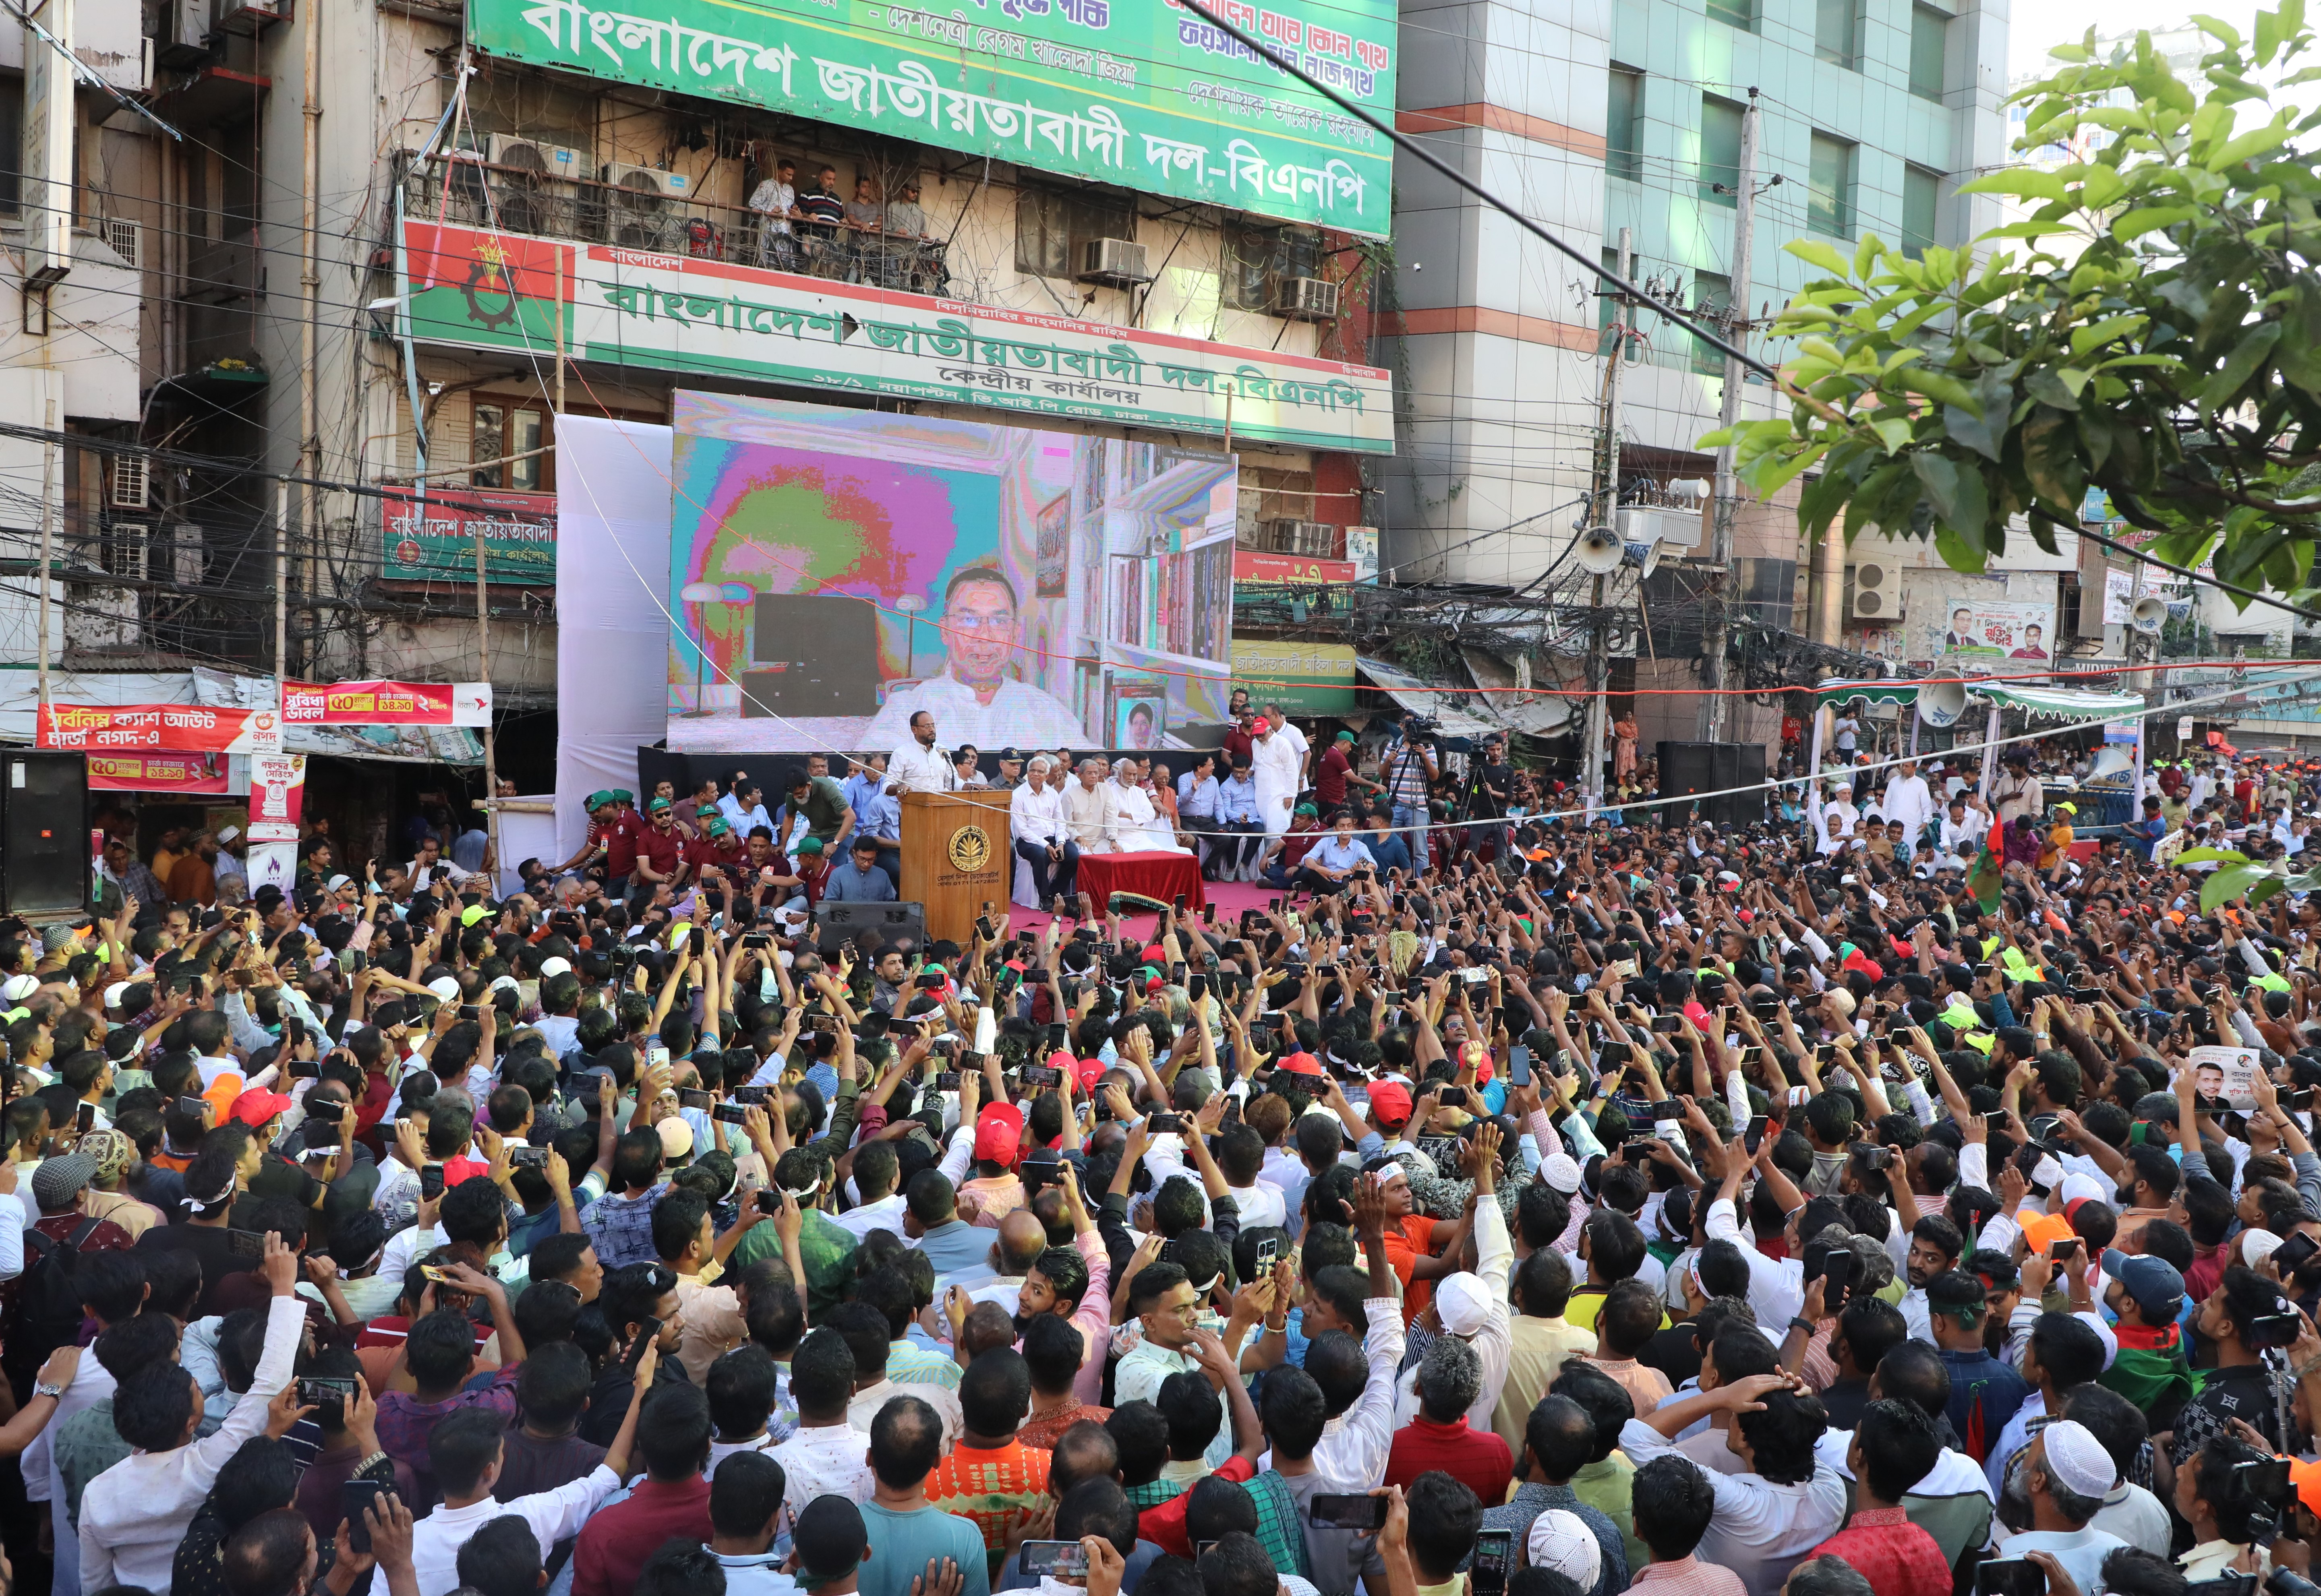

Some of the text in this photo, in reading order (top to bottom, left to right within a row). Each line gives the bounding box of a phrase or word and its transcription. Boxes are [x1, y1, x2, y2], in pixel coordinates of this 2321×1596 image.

[888, 6, 969, 46] দেশনেত্রী
[977, 27, 1025, 60] বেগম
[1032, 40, 1092, 78] খালেদা
[1096, 50, 1137, 89] জিয়া
[1261, 10, 1301, 45] যাবে
[1307, 23, 1351, 60] কোন
[1356, 39, 1388, 70] পথে
[1304, 54, 1374, 96] রাজপথে
[521, 0, 1368, 215] বাংলাদেশ জাতীয়তাবাদী দল-বিএনপি
[1189, 81, 1265, 118] দেশনায়ক
[1269, 99, 1322, 132] তারেক
[608, 249, 684, 271] বাংলাদেশ
[597, 282, 1367, 416] বাংলাদেশ জাতীয়তাবাদী দল-বিএনপি
[1342, 365, 1377, 378] জিন্দাবাদ
[936, 366, 1142, 405] কেন্দ্রীয় কার্যালয়
[1112, 410, 1150, 422] ঢাকা
[1985, 626, 2006, 642] মুক্তি
[1995, 635, 2013, 647] চাই
[1235, 651, 1353, 674] জাতীয়তাবাদী মহিলা দল
[286, 693, 324, 708] সুবিধা
[418, 694, 429, 712] ২
[458, 700, 475, 709] বিকাশ
[47, 708, 217, 729] সর্বনিম্ন ক্যাশ আউট
[287, 707, 325, 720] ডাবল
[96, 730, 159, 745] নগদ-এ
[253, 731, 277, 743] নগদ
[190, 762, 201, 780] ২
[261, 761, 289, 770] পছন্দের
[266, 769, 294, 779] সেভিংস
[2229, 1088, 2242, 1096] মুক্তি
